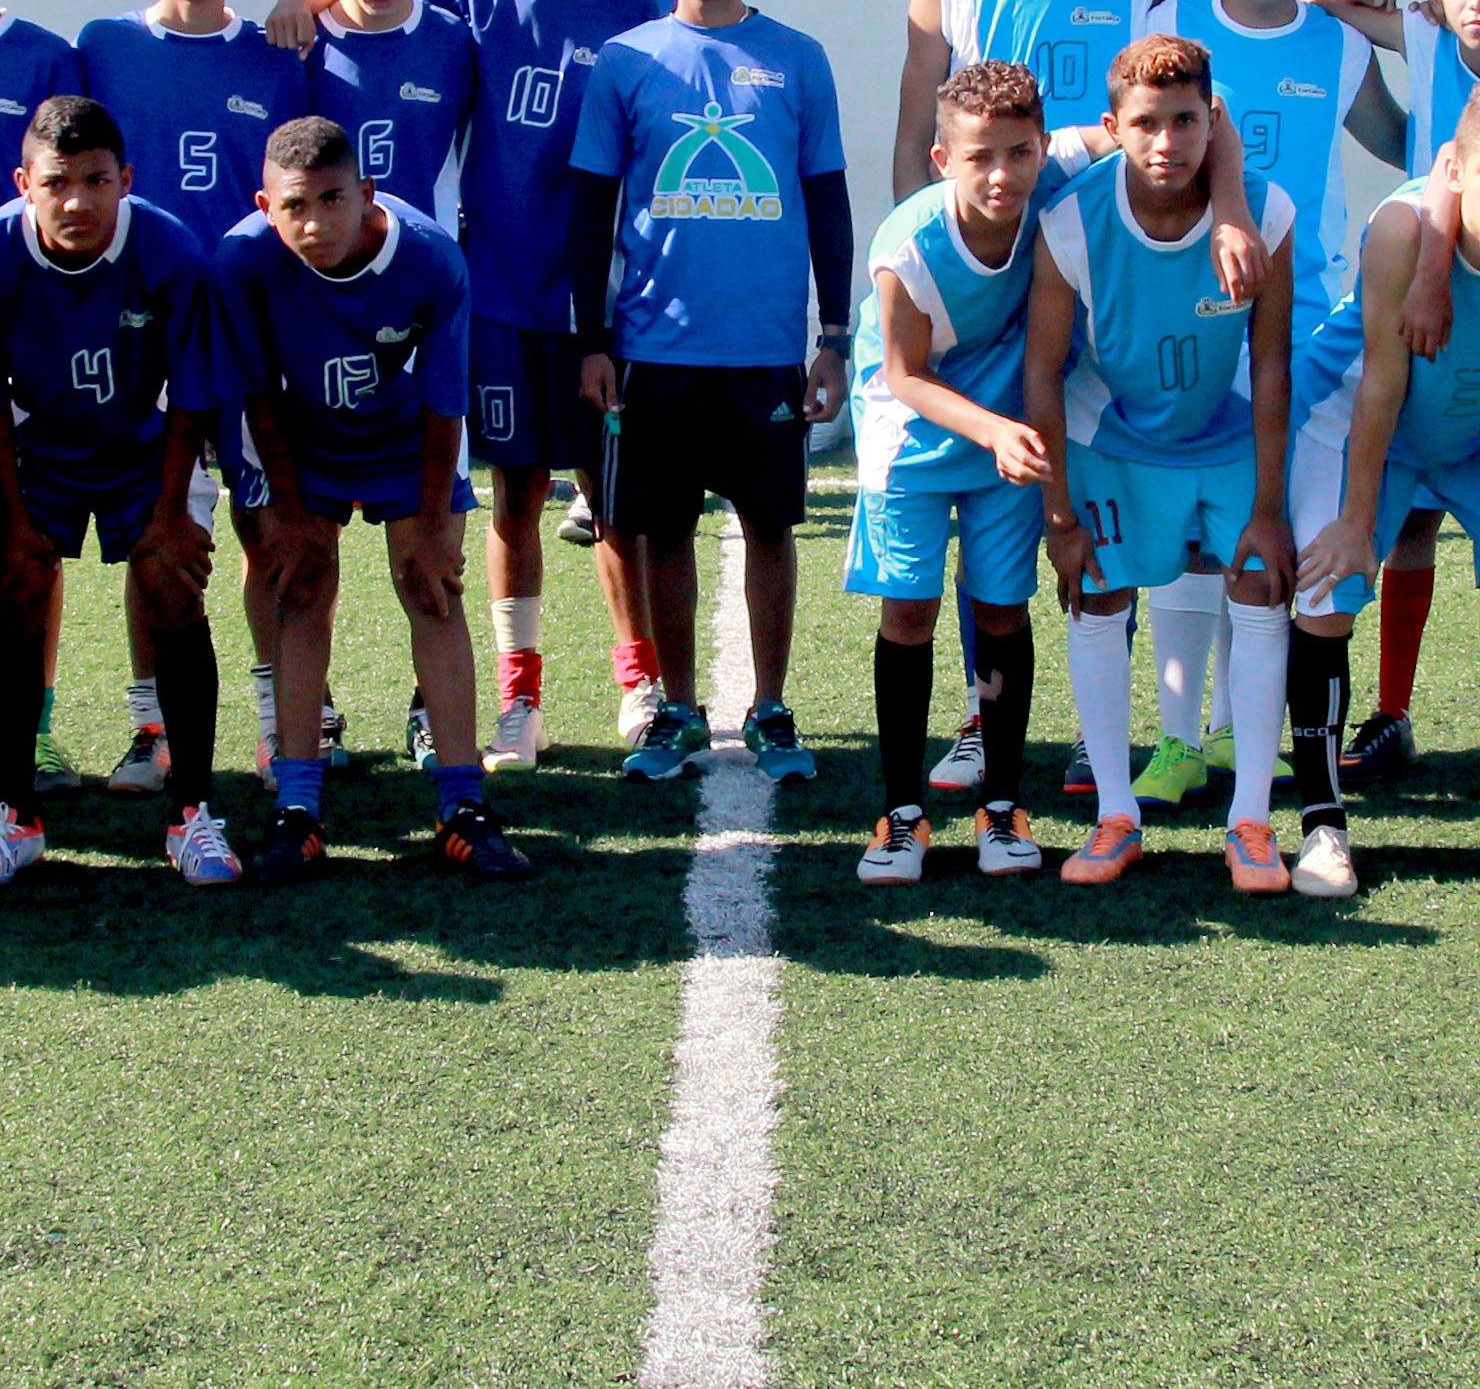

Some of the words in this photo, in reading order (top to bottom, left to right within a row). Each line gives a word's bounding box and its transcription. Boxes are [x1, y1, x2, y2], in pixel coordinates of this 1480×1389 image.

[506, 65, 564, 127] 10
[1036, 40, 1088, 101] 10
[179, 131, 218, 191] 5
[358, 119, 394, 180] 6
[1240, 110, 1281, 170] 9
[684, 181, 744, 194] ATLETA
[71, 348, 115, 404] 4
[1157, 334, 1199, 392] 11
[1085, 499, 1123, 548] 11
